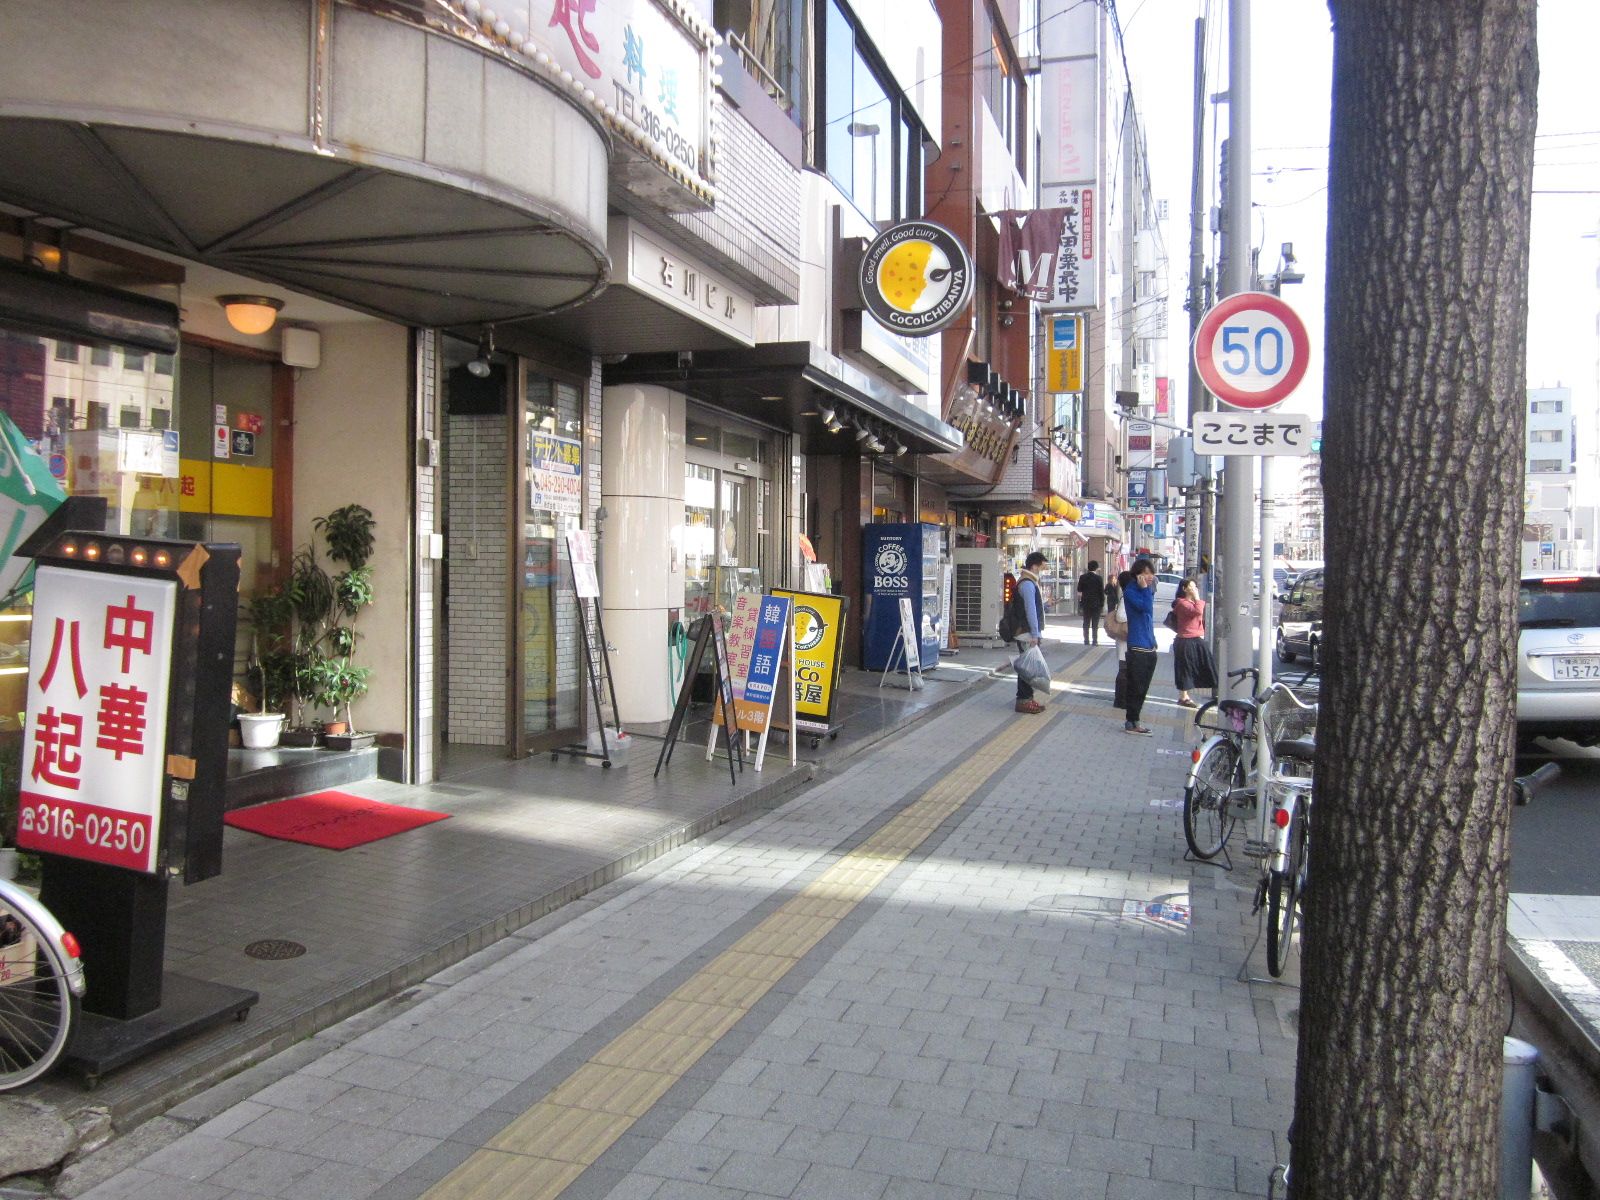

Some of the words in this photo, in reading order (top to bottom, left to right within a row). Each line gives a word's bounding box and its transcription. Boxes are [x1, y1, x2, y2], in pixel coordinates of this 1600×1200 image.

[623, 23, 679, 125] 料理
[640, 104, 695, 170] 316-0250
[865, 259, 876, 284] Good
[891, 227, 914, 242] Good
[915, 228, 938, 241] curry
[660, 256, 736, 319] 石川ビル
[1222, 326, 1283, 375] 50
[1201, 422, 1302, 446] ここまで
[878, 543, 904, 553] COFFEE
[874, 576, 908, 588] BOSS
[96, 595, 154, 761] 中華
[799, 659, 825, 669] HOUSE
[1566, 666, 1600, 677] 15-72
[31, 617, 88, 790] 八起
[37, 803, 146, 854] 316-0250
